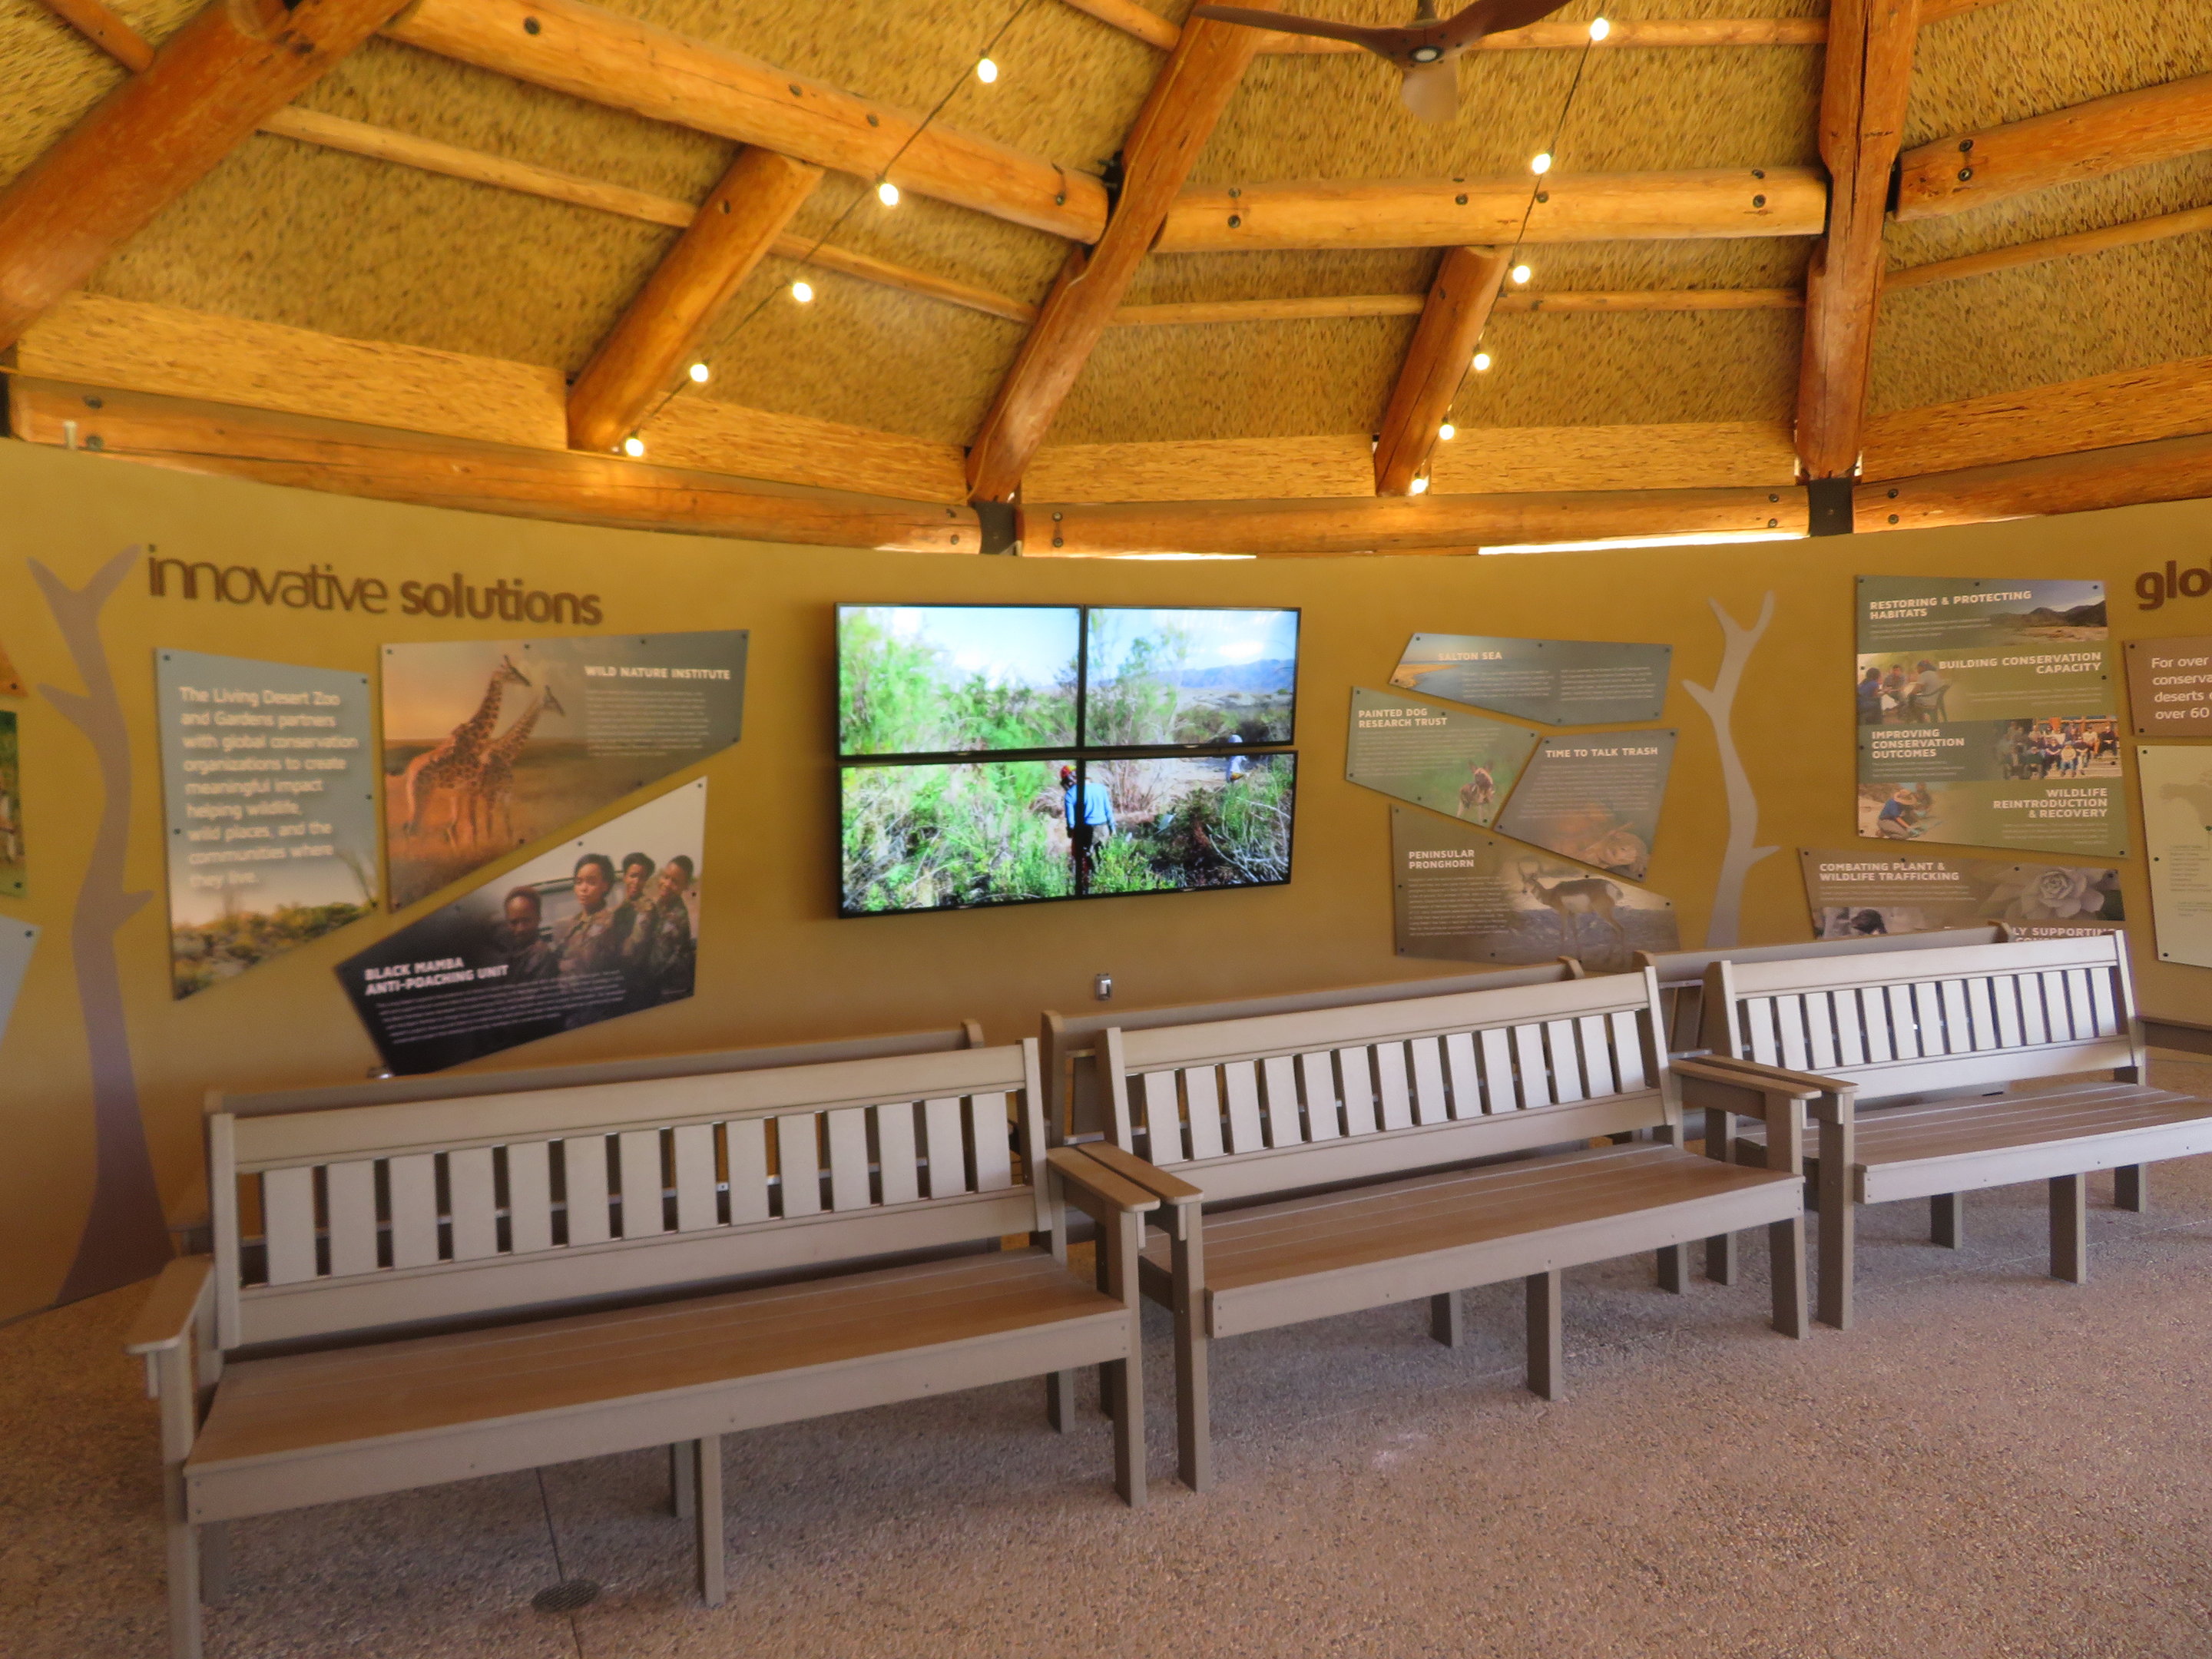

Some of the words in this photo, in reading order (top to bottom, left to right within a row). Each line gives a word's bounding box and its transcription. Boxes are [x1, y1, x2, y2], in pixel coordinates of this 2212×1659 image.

[148, 544, 388, 614] innovative
[400, 572, 603, 625] solutions
[2135, 559, 2212, 611] glo
[1869, 598, 1938, 610] RESTORING
[1941, 597, 1950, 605] &
[1953, 591, 2032, 604] PROTECTING
[1869, 608, 1928, 620] HABITATS
[1482, 651, 1503, 660] SEA
[1939, 658, 1998, 669] BUILDING
[2002, 652, 2101, 666] CONSERVATION
[2036, 662, 2102, 674] CAPACITY
[2151, 657, 2174, 669] For
[2177, 657, 2209, 667] over
[584, 666, 617, 677] WILD
[620, 667, 667, 677] NATURE
[671, 669, 730, 680] INSTITUTE
[179, 687, 209, 702] The
[211, 688, 260, 707] Living
[262, 690, 310, 704] Desert
[311, 691, 340, 706] Zoo
[2154, 690, 2204, 703] deserts
[180, 711, 210, 726] and
[213, 710, 275, 726] Gardens
[1358, 709, 1402, 718] PAINTED
[1406, 708, 1428, 717] DOG
[2155, 710, 2186, 720] over
[2190, 707, 2210, 718] 60
[1359, 718, 1412, 728] RESEARCH
[1415, 717, 1448, 726] TRUST
[1872, 729, 1941, 740] IMPROVING
[269, 737, 359, 749] conservation
[1872, 738, 1965, 750] CONSERVATION
[1545, 750, 1571, 758] TIME
[1574, 749, 1588, 757] TO
[1591, 748, 1618, 757] TALK
[1622, 747, 1658, 757] TRASH
[1872, 749, 1937, 759] OUTCOMES
[2046, 788, 2108, 797] WILDLIFE
[1993, 799, 2108, 809] REINTRODUCTION
[2028, 810, 2036, 818] &
[2039, 809, 2108, 818] RECOVERY
[1409, 849, 1475, 859] PENINSULAR
[1409, 859, 1475, 869] PRONGHORN
[1820, 863, 1889, 872] COMBATING
[1893, 863, 1933, 871] PLANT
[1937, 862, 1945, 871] &
[1820, 873, 1876, 881] WILDLIFE
[1879, 873, 1959, 881] TRAFFICKING
[2032, 927, 2115, 936] SUPPORTIN
[364, 964, 411, 981] BLACK
[413, 957, 465, 975] MAMBA
[365, 969, 475, 996] ANTI-POACHING
[476, 965, 509, 979] UNIT
